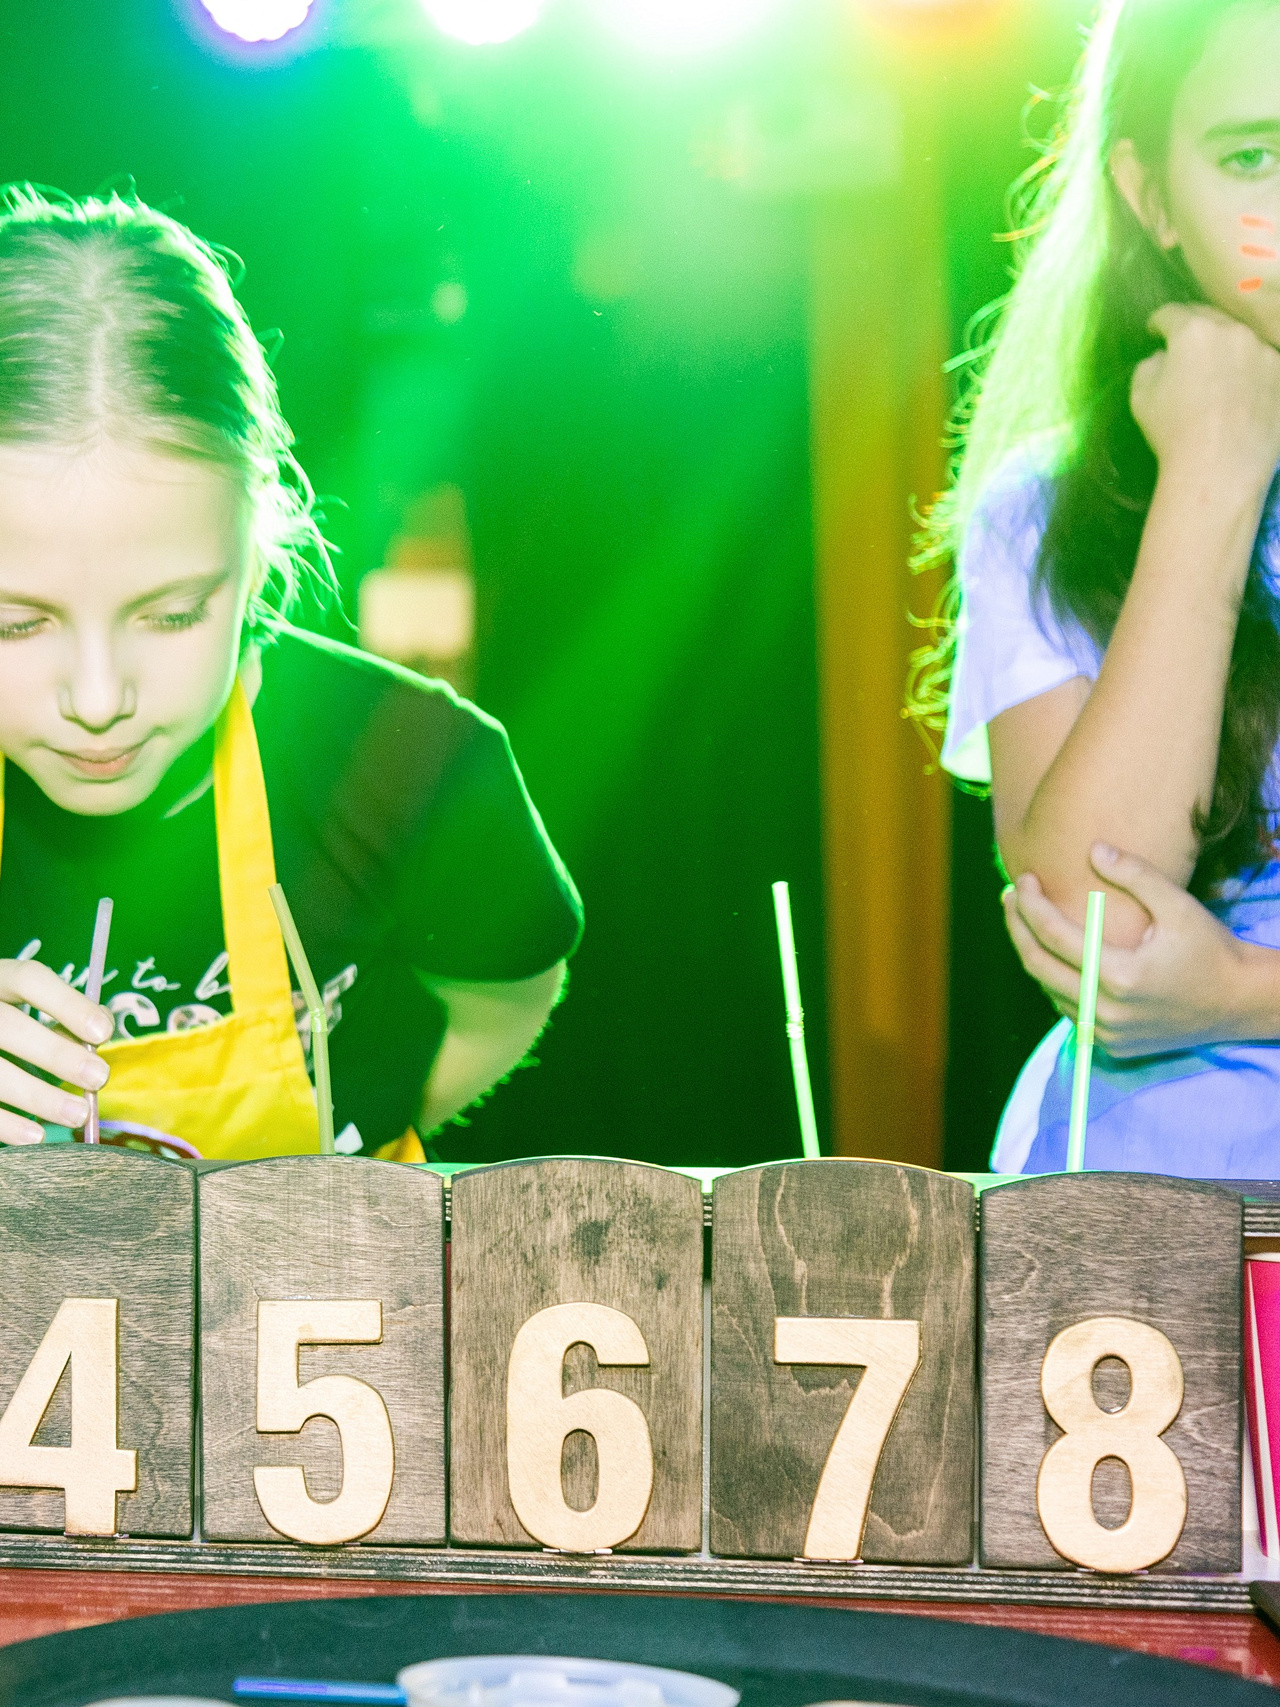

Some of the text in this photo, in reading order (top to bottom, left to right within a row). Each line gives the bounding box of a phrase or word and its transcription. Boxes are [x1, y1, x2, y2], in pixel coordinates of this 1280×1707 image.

[131, 956, 181, 992] to
[252, 1299, 395, 1545] 5
[506, 1301, 654, 1552] 6
[774, 1316, 922, 1561] 7
[1036, 1316, 1188, 1574] 8
